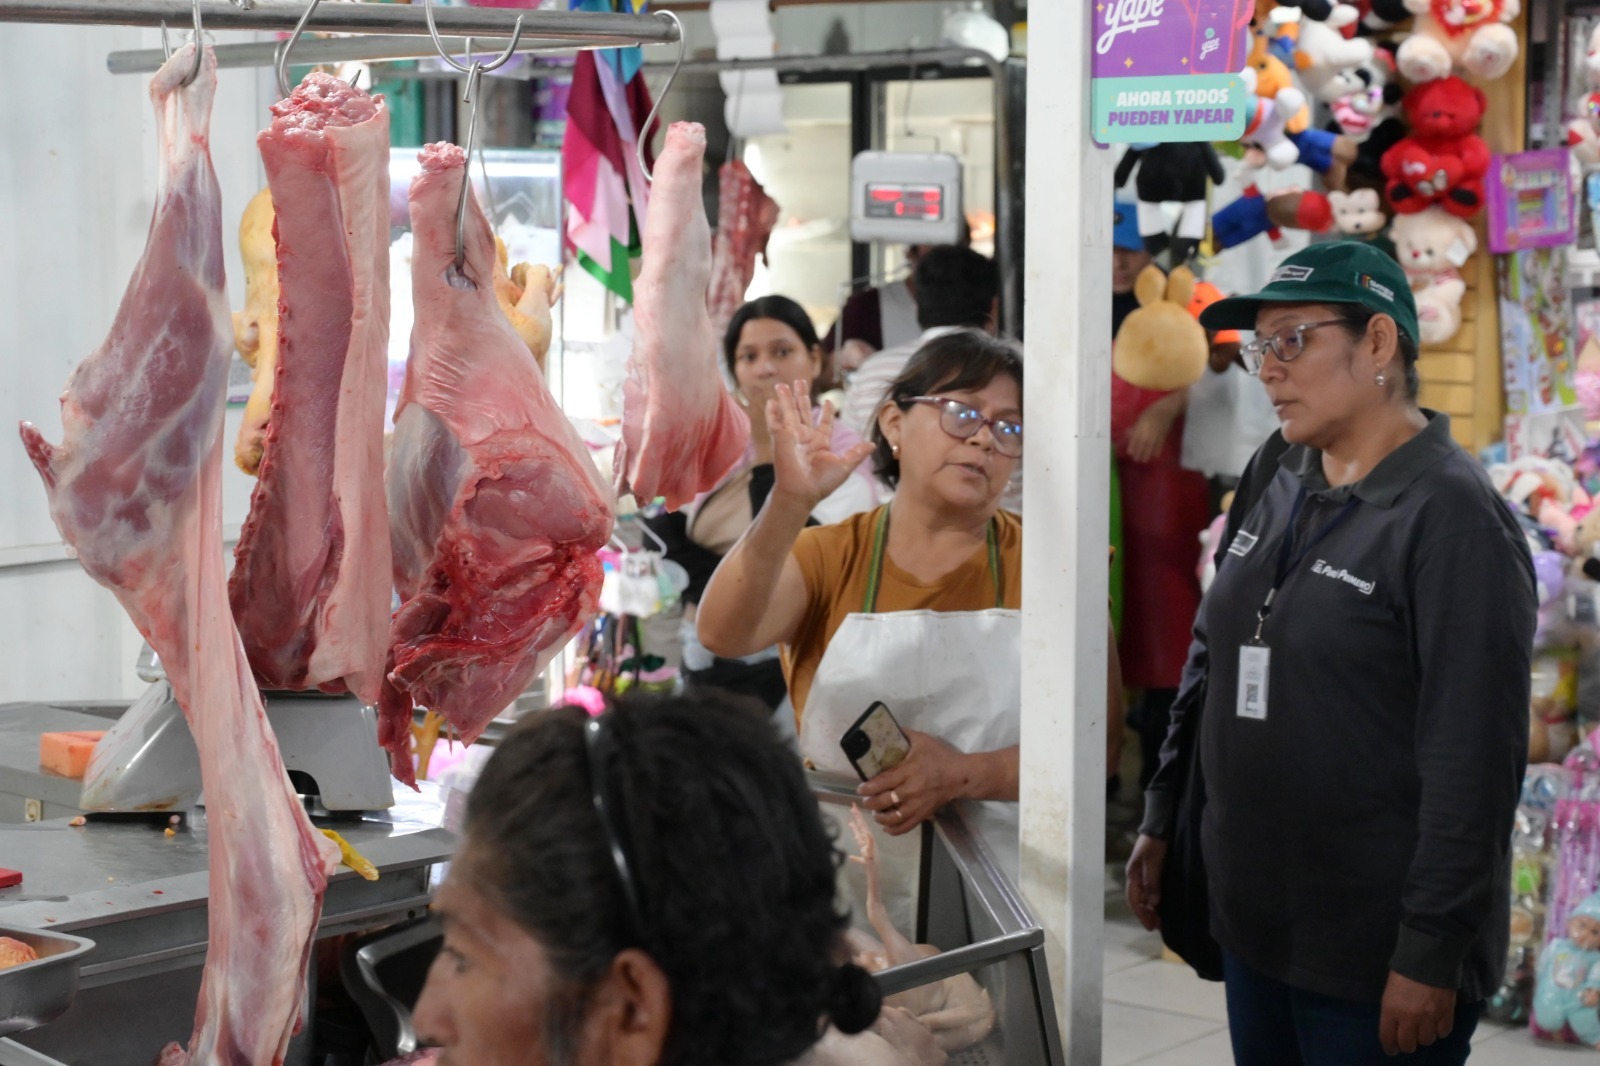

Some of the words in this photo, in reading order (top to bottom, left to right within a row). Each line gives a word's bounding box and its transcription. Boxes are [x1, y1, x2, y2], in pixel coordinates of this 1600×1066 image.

[1096, 0, 1164, 55] yape
[1200, 38, 1220, 60] yape
[1116, 91, 1172, 107] AHORA
[1175, 88, 1229, 105] TODOS
[1108, 110, 1169, 126] PUEDEN
[1173, 108, 1234, 124] YAPEAR
